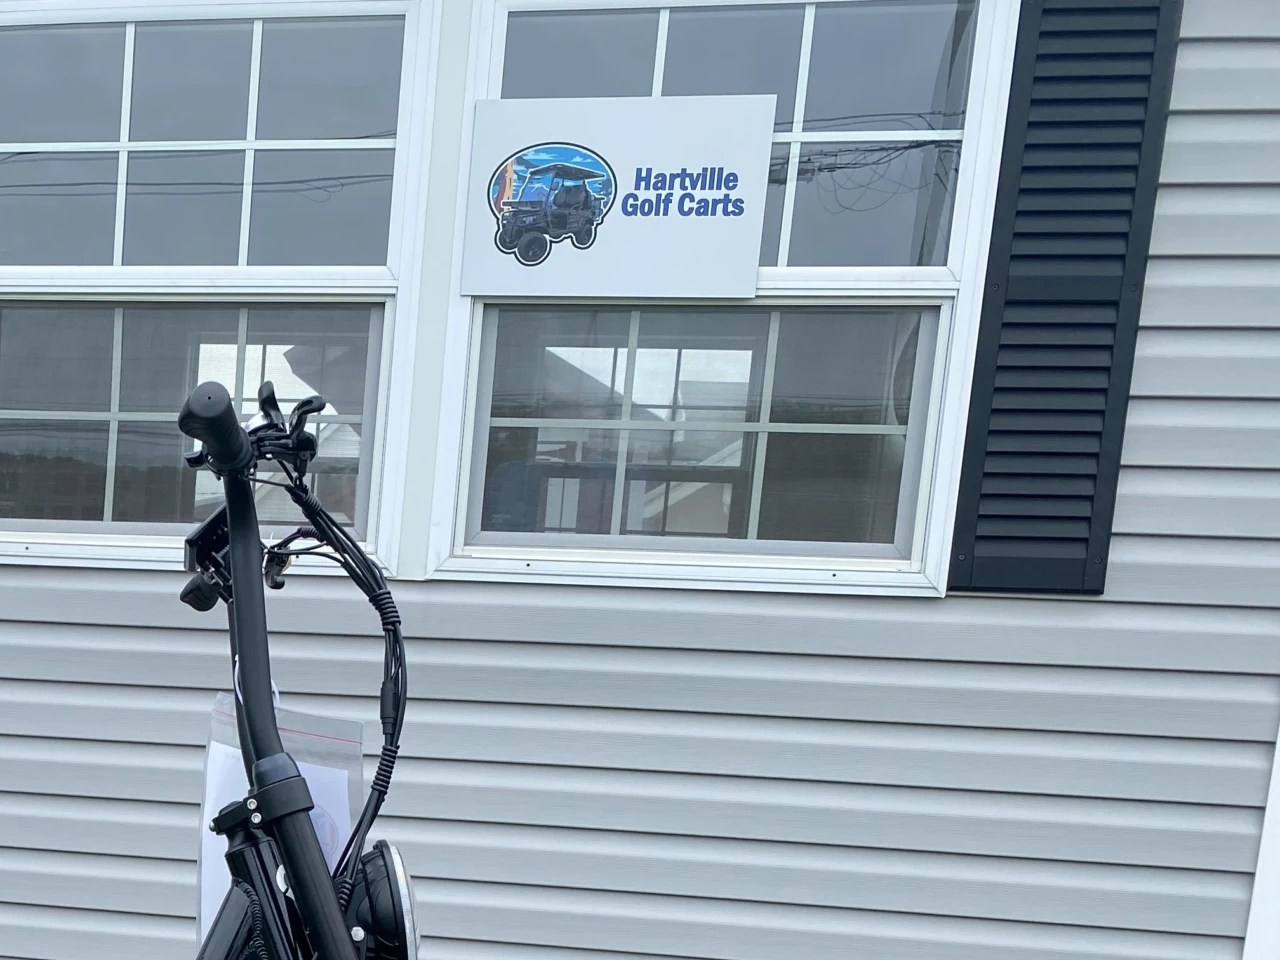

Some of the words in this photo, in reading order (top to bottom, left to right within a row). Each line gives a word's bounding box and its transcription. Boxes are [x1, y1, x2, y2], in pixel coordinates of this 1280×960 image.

[633, 166, 739, 192] Hartville
[621, 192, 673, 217] Golf
[677, 193, 745, 217] Carts
